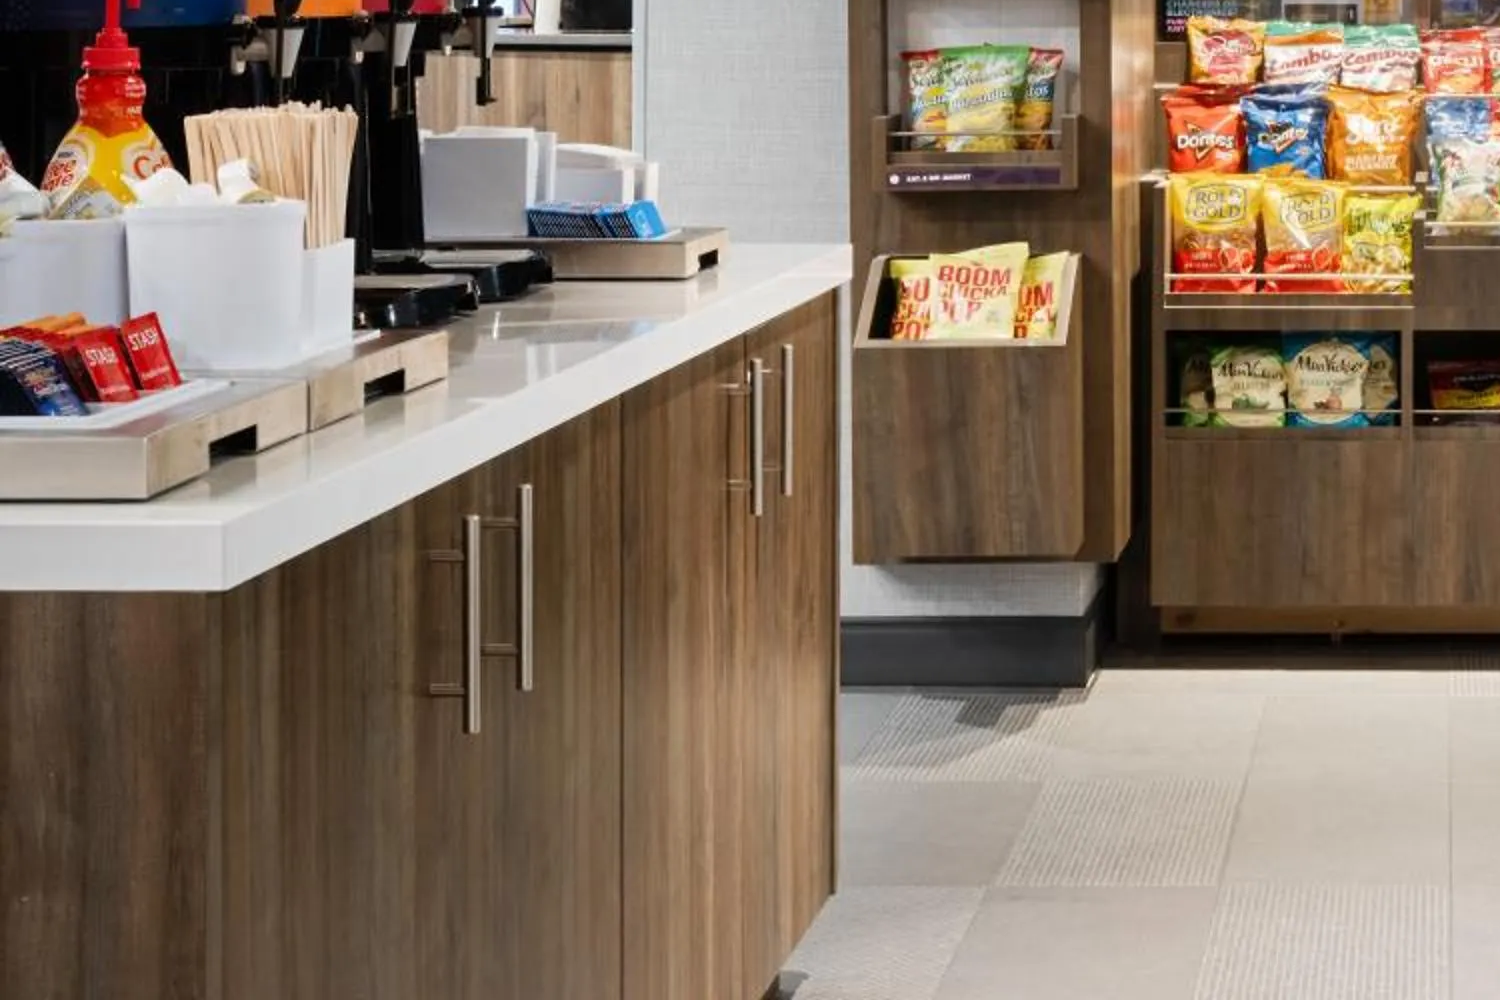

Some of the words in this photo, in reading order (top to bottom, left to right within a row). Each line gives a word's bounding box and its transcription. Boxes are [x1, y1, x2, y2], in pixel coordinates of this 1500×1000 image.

[1176, 133, 1234, 150] Doritos
[937, 264, 1012, 288] BOOM
[127, 327, 159, 351] STASH
